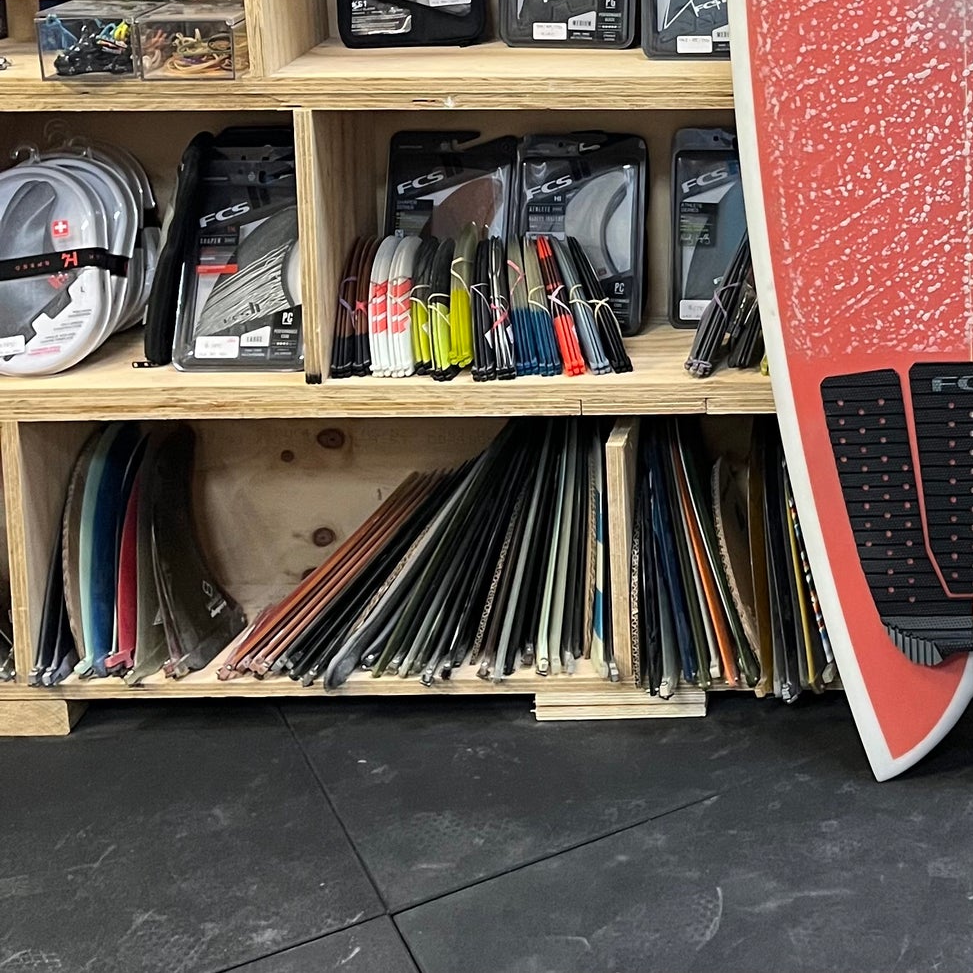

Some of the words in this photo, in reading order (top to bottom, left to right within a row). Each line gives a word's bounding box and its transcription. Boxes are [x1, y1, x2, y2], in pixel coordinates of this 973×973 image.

[396, 170, 444, 195] FCS
[526, 174, 573, 201] FCS
[681, 167, 729, 194] FCS
[199, 201, 251, 228] FCS
[281, 311, 294, 325] PC
